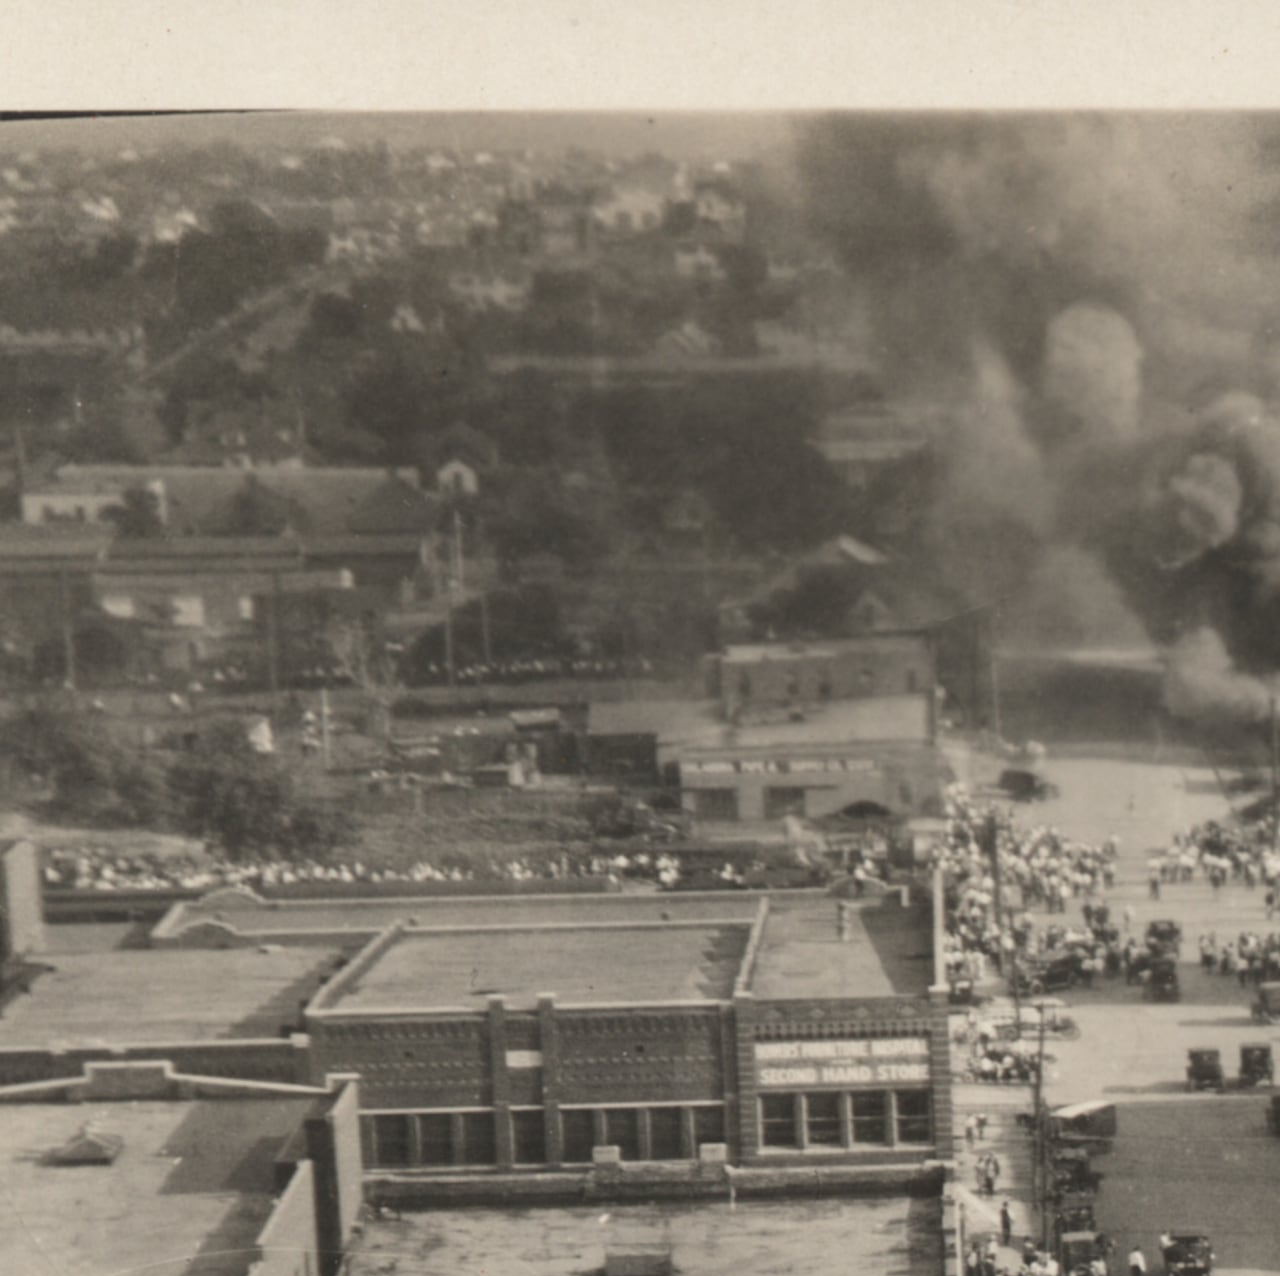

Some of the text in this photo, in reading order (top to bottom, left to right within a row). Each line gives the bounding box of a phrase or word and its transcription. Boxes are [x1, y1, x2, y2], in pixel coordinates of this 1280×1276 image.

[759, 1064, 930, 1086] SECOND HAND STORE
